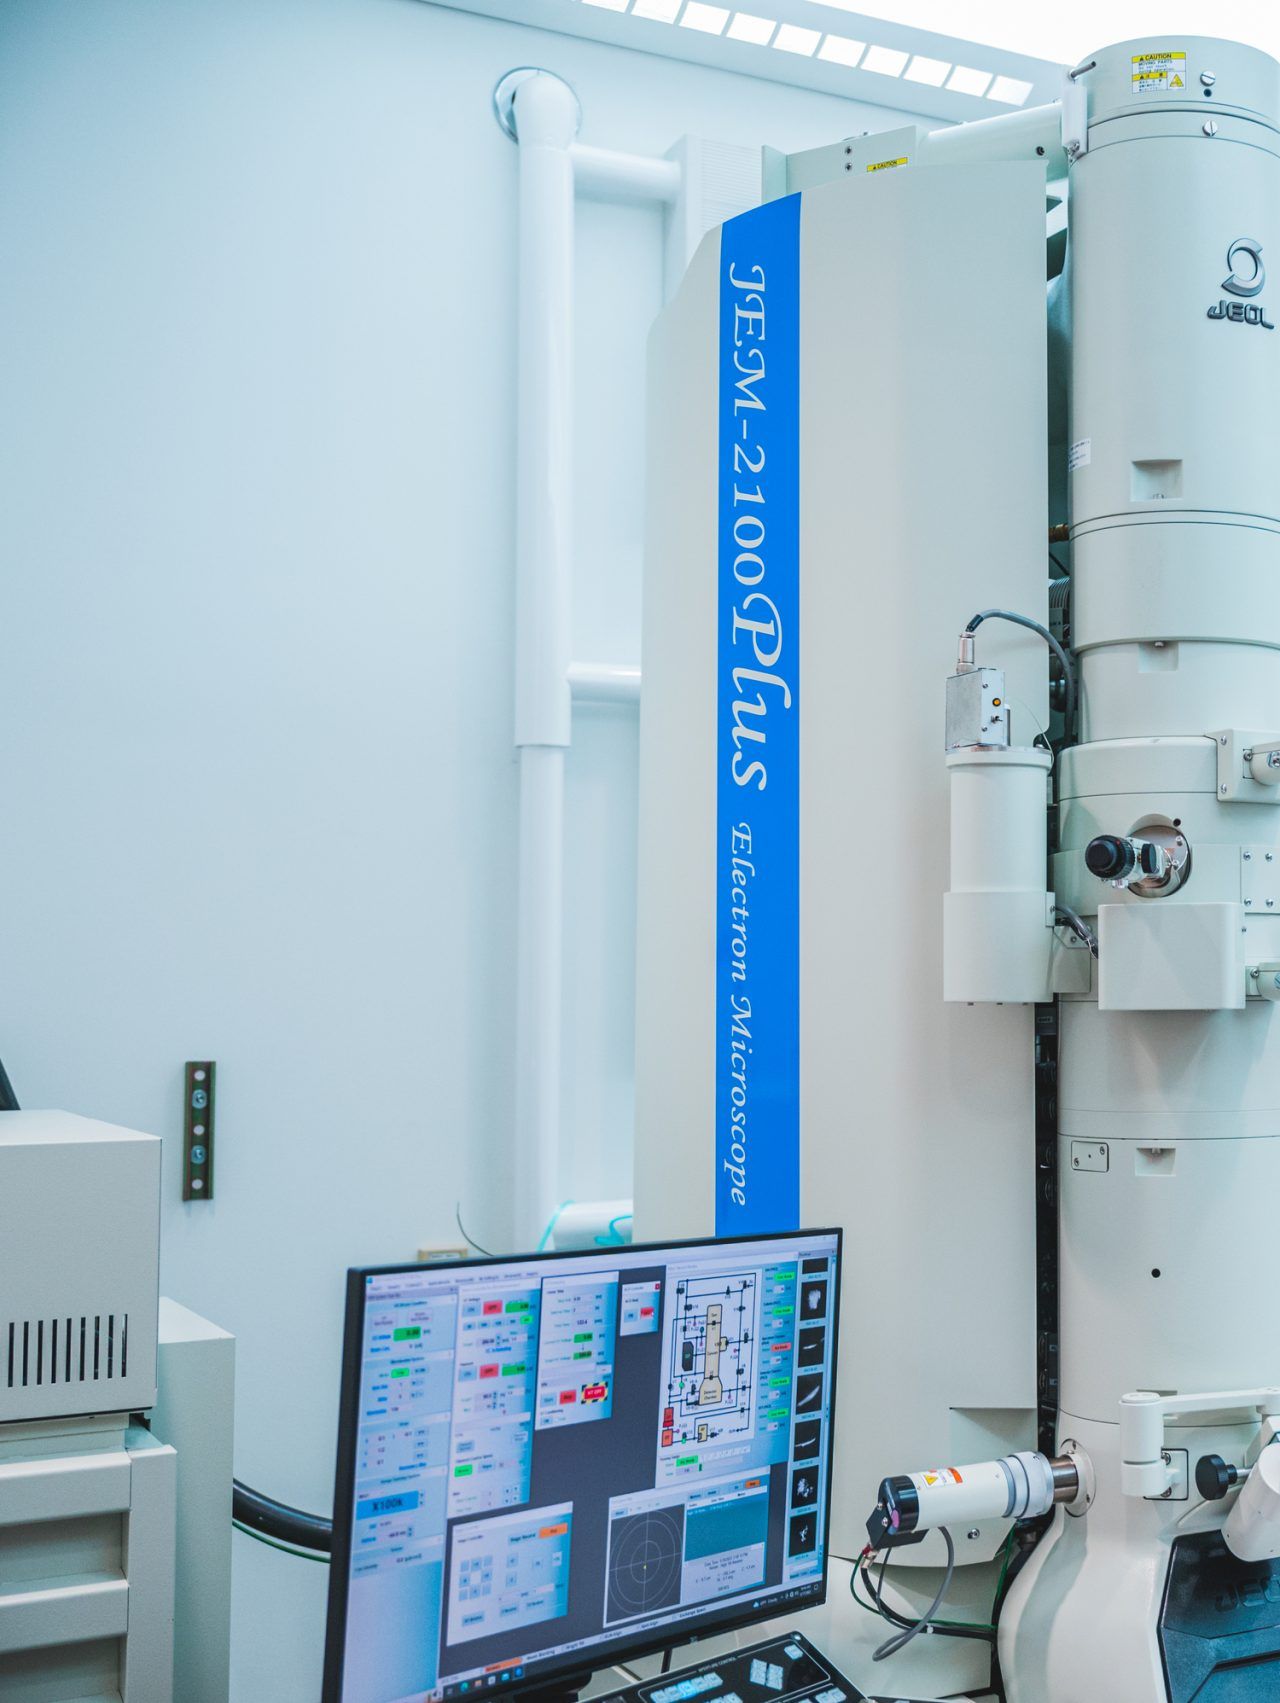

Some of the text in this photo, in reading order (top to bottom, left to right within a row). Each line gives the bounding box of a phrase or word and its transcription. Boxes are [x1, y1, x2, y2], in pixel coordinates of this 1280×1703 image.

[877, 160, 898, 169] CAUTION
[1206, 300, 1274, 330] JEOL
[731, 821, 755, 983] Electron
[724, 995, 753, 1207] Microscope
